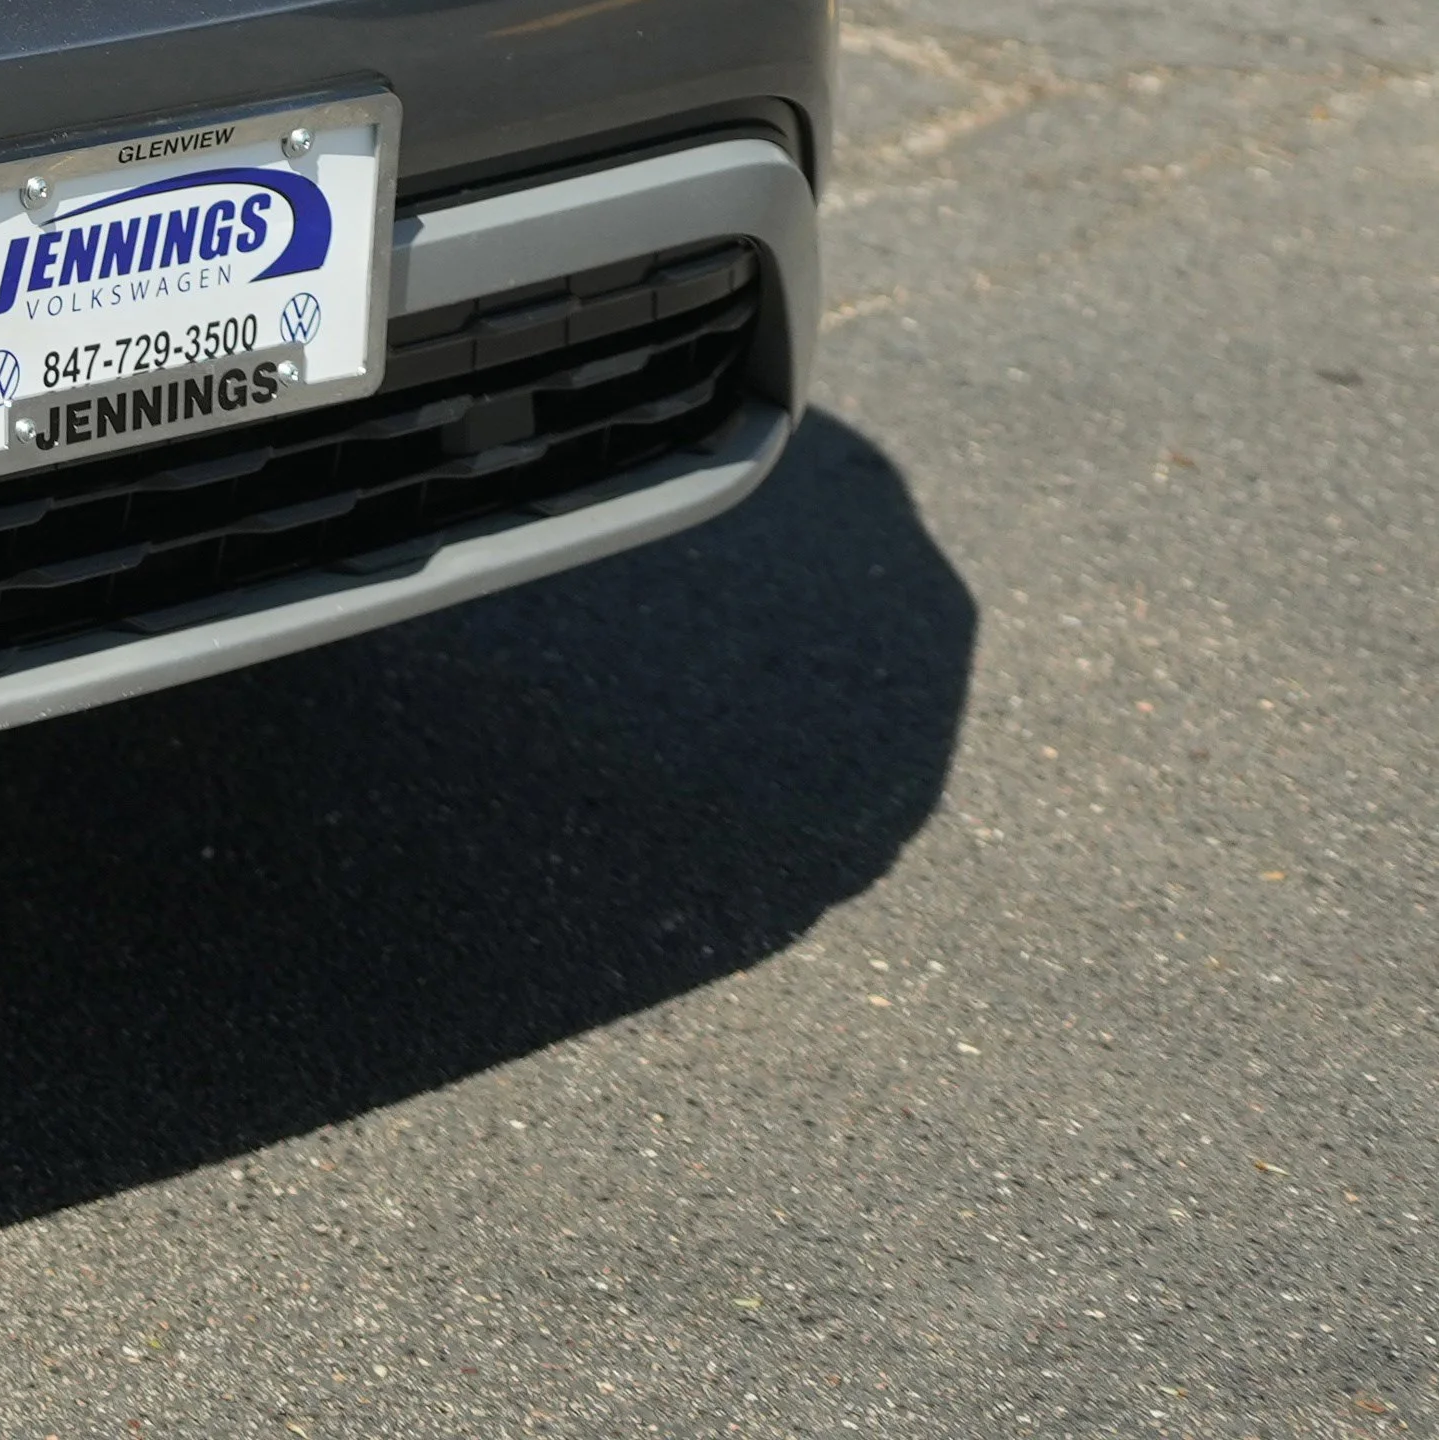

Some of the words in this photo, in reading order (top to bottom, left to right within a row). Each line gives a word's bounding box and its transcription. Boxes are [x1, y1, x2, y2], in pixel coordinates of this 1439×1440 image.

[117, 126, 236, 165] GLENVIEW
[26, 263, 232, 320] VOLKSWAGEN
[42, 313, 259, 389] 847-729-3500
[35, 360, 280, 452] JENNINGS
